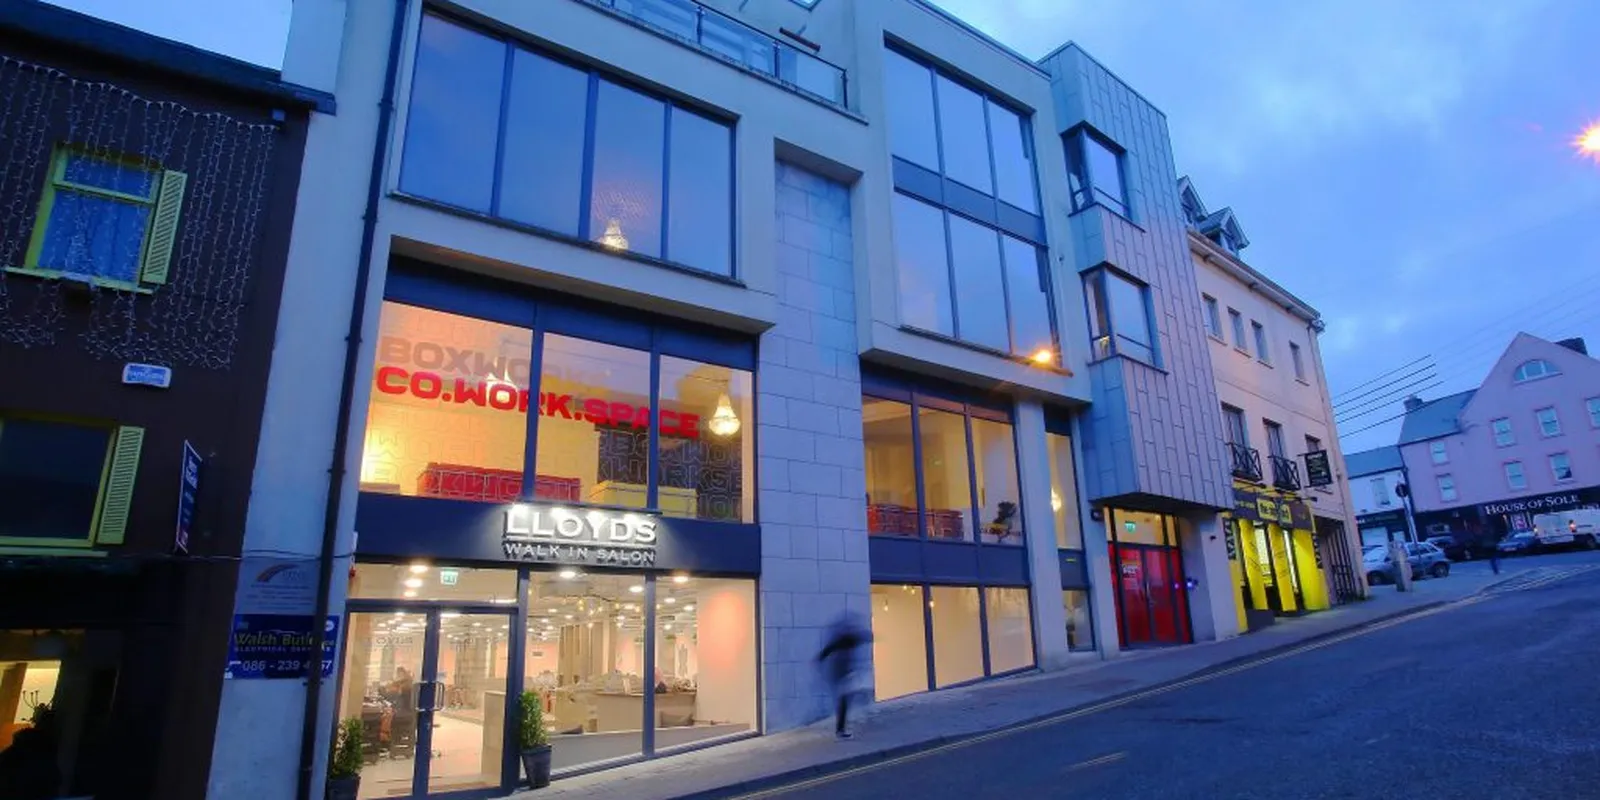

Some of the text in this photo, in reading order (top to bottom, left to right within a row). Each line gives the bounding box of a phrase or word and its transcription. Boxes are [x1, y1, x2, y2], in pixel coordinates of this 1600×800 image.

[376, 366, 699, 438] CO.WORK.SPACE
[1485, 494, 1578, 515] HOUSE OF SOLE
[507, 508, 657, 543] LLOYDS
[505, 543, 655, 562] WALK IN SALON
[234, 631, 277, 645] Walsh
[282, 632, 319, 646] Butl
[243, 660, 266, 671] 086
[277, 659, 301, 671] 239
[302, 660, 332, 671] 47
